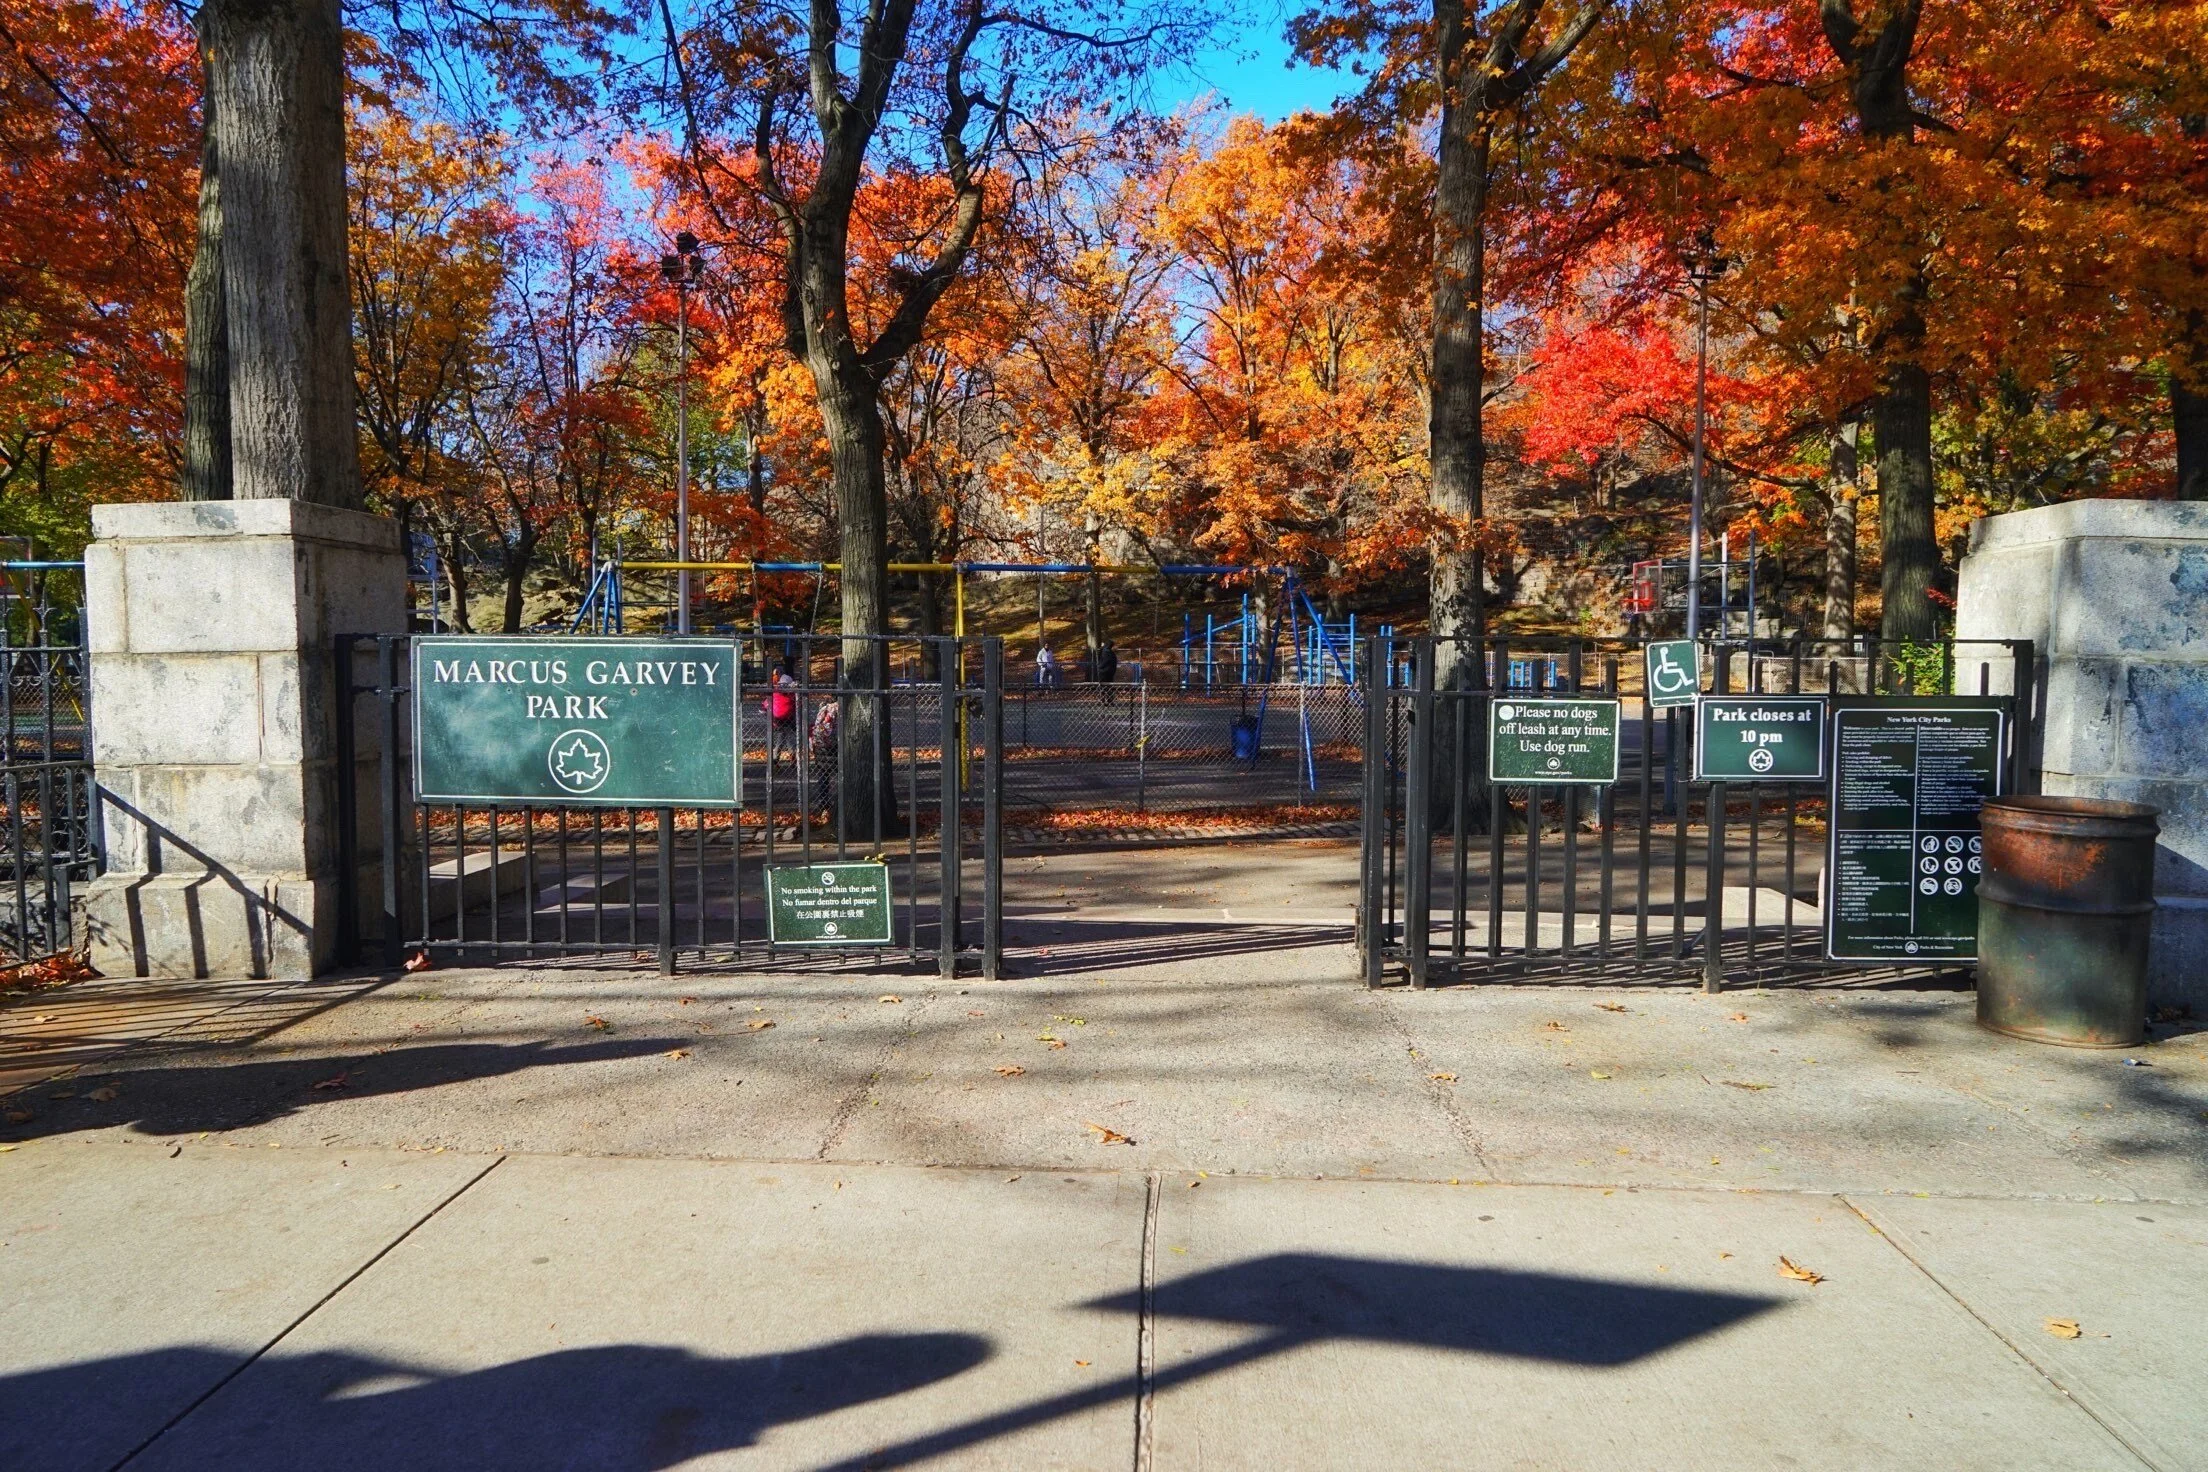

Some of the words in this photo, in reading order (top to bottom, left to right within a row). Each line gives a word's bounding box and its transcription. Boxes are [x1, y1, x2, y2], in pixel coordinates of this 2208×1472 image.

[433, 660, 568, 684] MARCUS
[586, 661, 720, 686] GARVEY
[526, 695, 608, 719] PARK
[1515, 705, 1550, 718] Please
[1553, 708, 1568, 718] no
[1571, 706, 1597, 721] dogs
[1713, 708, 1747, 721] Park
[1750, 708, 1794, 721] closes
[1797, 709, 1812, 721] at
[1918, 716, 1932, 724] City
[1499, 723, 1517, 734] off
[1518, 724, 1546, 735] leash
[1548, 725, 1558, 735] at
[1561, 727, 1581, 737] any
[1584, 724, 1611, 735] time.
[1740, 730, 1757, 743] 10
[1759, 731, 1783, 746] pm
[1519, 740, 1541, 752] Use
[1544, 740, 1565, 755] dog
[1568, 744, 1590, 752] run.
[781, 887, 792, 895] No
[793, 887, 823, 895] smoking
[825, 885, 847, 893] within
[861, 885, 877, 894] park
[853, 898, 877, 906] parque
